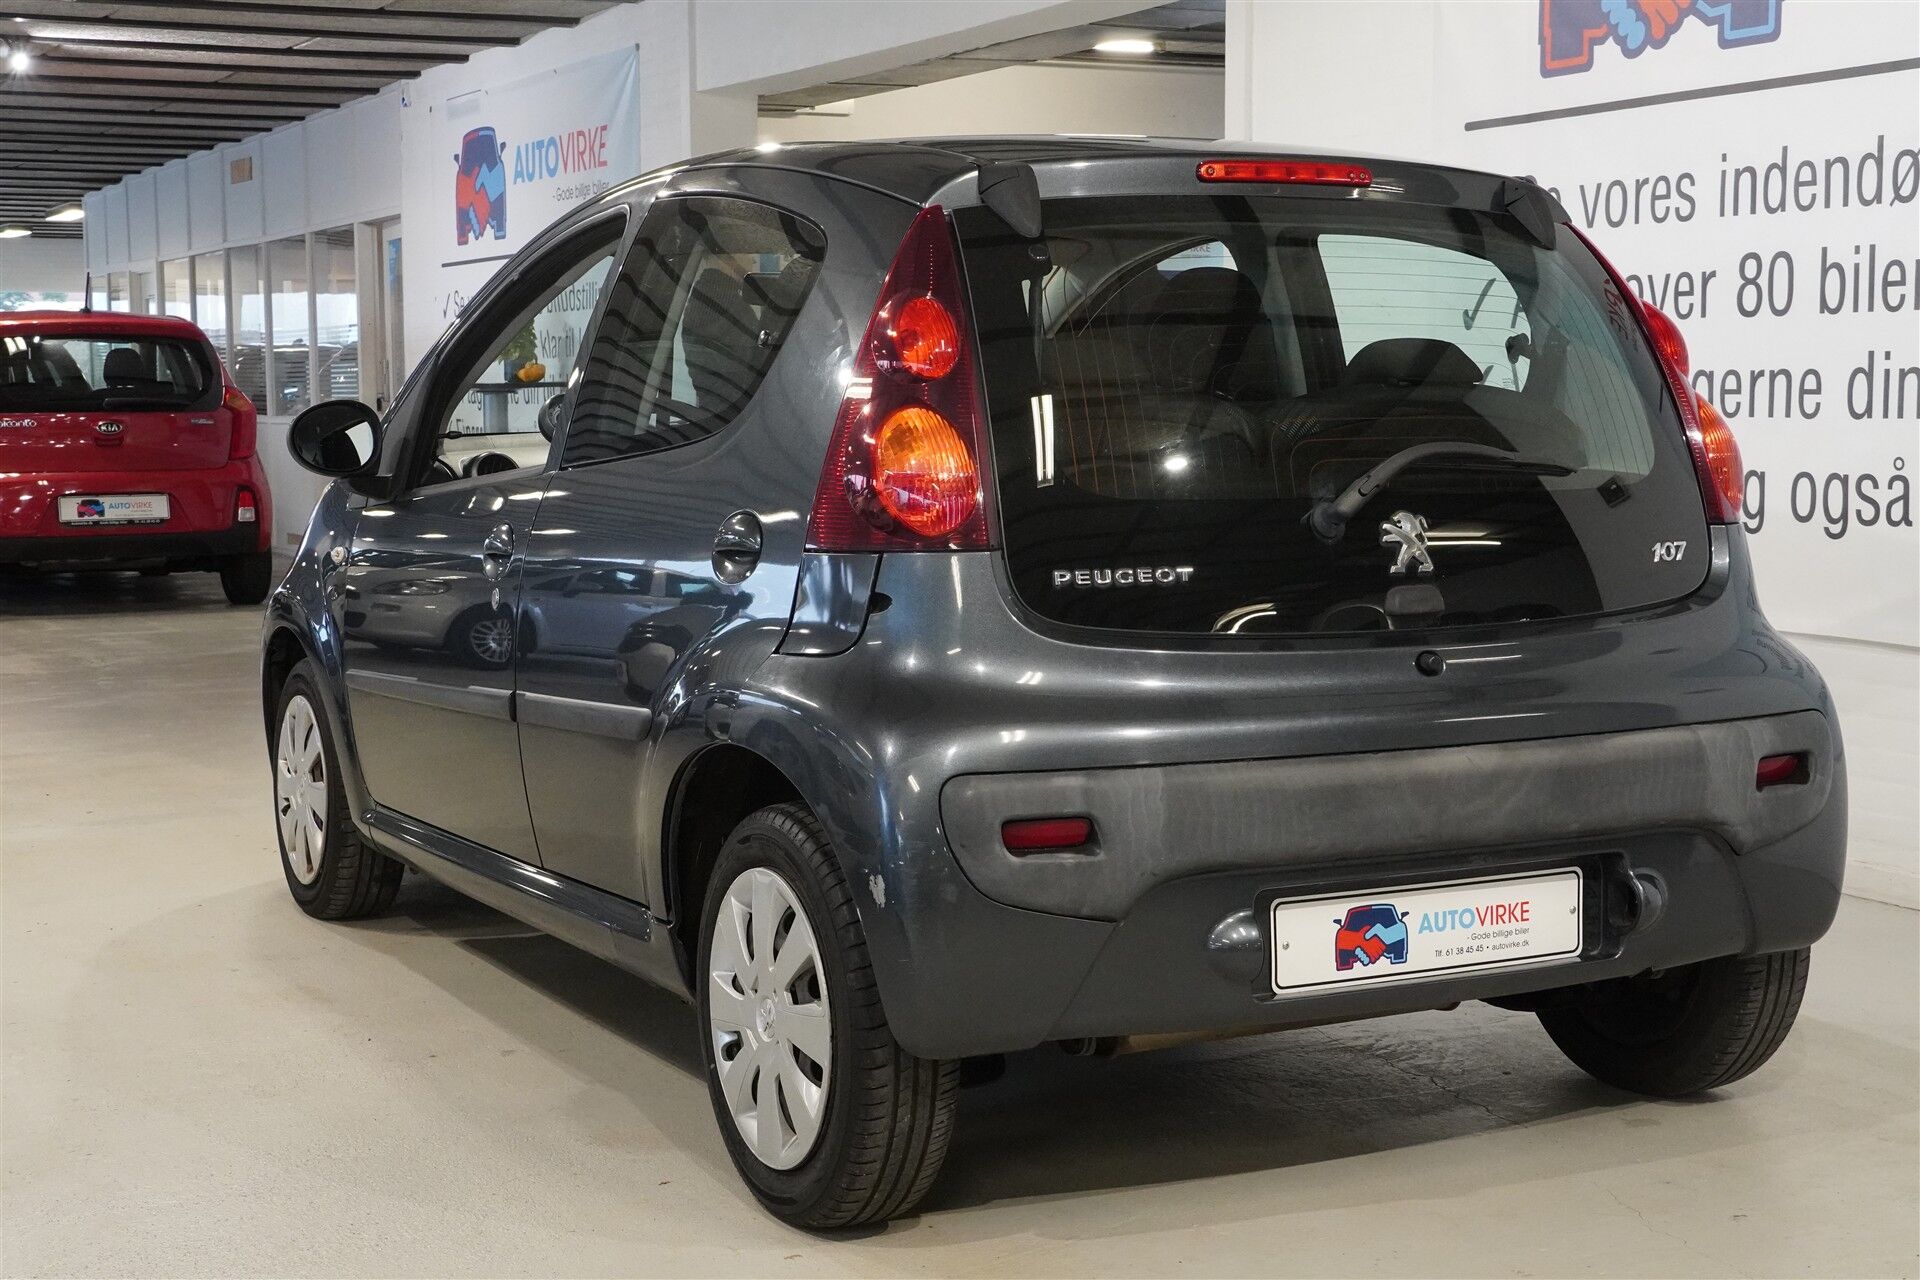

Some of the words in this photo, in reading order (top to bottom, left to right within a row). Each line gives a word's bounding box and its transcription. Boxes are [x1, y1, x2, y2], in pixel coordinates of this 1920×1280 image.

[513, 124, 608, 185] AUTOVIRKE
[1579, 172, 1696, 229] vores
[1736, 251, 1794, 318] 80
[540, 329, 561, 359] klar
[566, 327, 575, 358] til
[109, 501, 152, 510] AUTOVIRKE
[1790, 456, 1913, 540] også
[1651, 541, 1687, 562] 107
[1053, 565, 1194, 586] PEUGEOT
[1418, 901, 1530, 934] AUTOVIRKE
[1445, 948, 1454, 957] 61
[1455, 947, 1464, 955] 38
[1465, 945, 1474, 954] 45
[1476, 944, 1484, 953] 45
[1491, 939, 1530, 951] autovirke.dk
[1471, 932, 1491, 941] Gode
[1492, 929, 1513, 939] billige
[1515, 927, 1530, 936] biler
